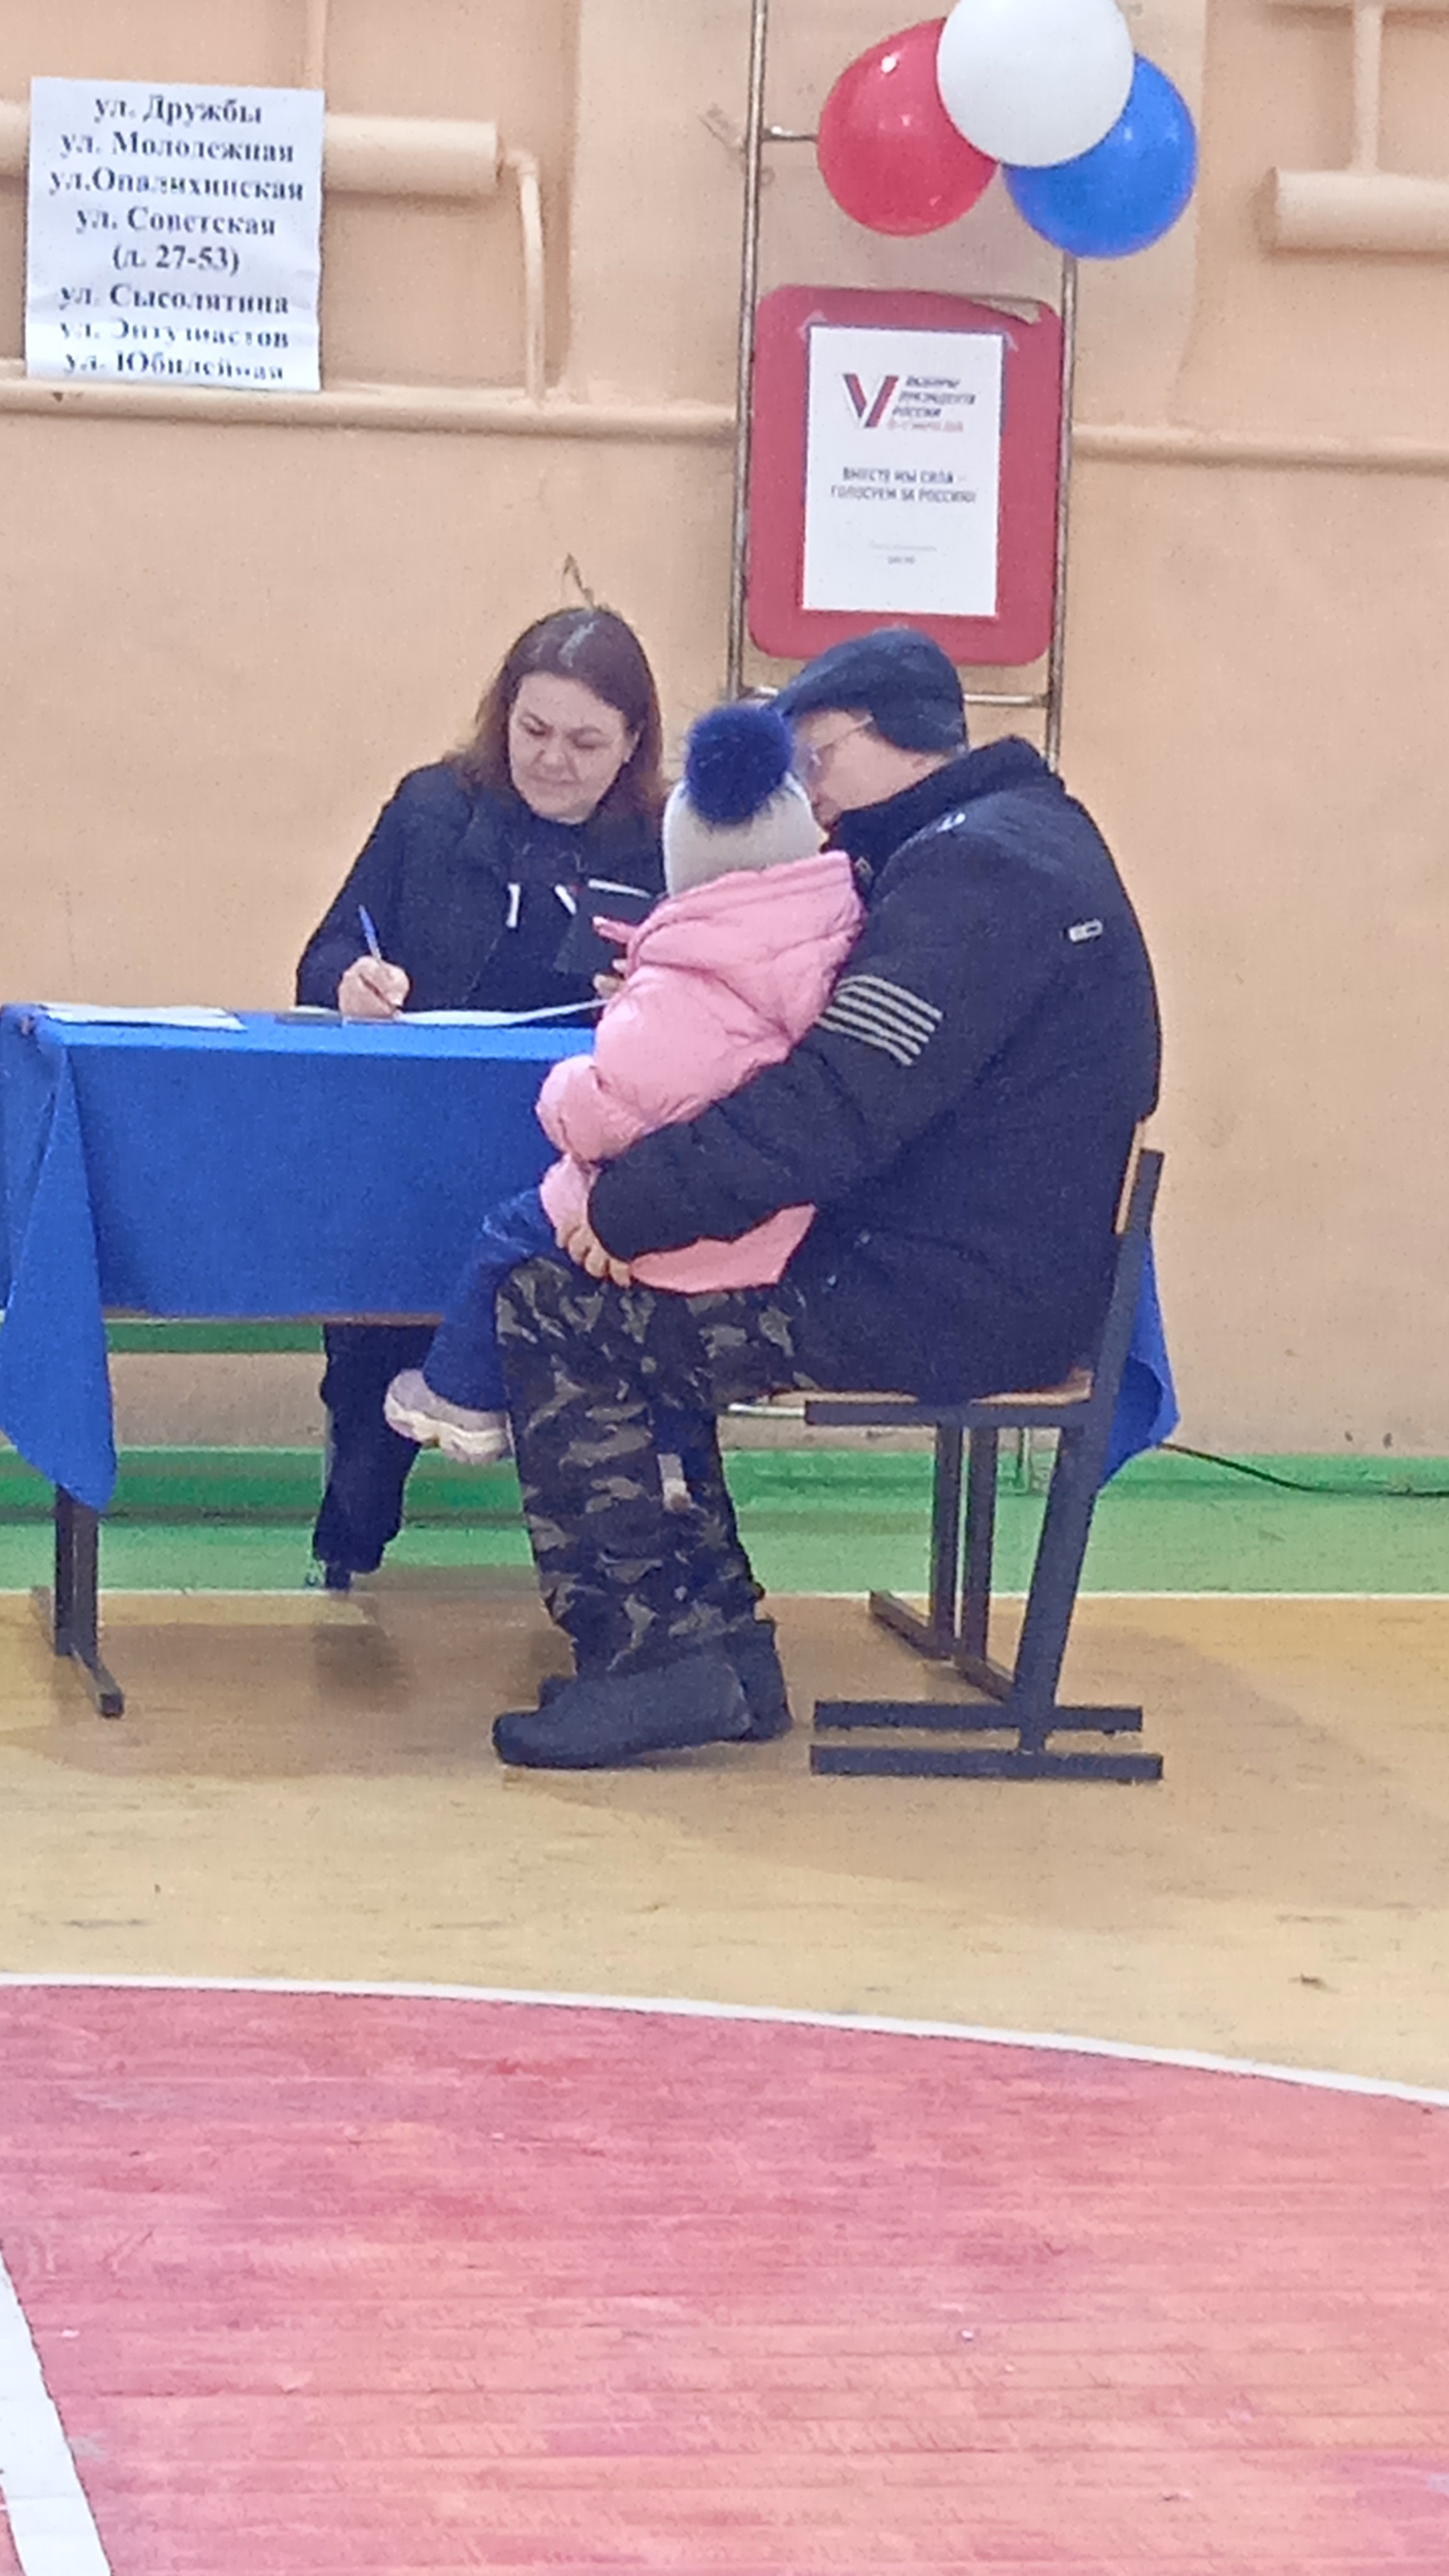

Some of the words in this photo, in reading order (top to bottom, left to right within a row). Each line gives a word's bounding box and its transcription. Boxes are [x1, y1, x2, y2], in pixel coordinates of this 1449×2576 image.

[94, 97, 136, 123] ул.
[143, 95, 262, 127] Дружбы
[60, 133, 101, 158] ул.
[75, 209, 118, 235] ул.
[128, 206, 276, 236] Советская
[155, 244, 240, 276] 27-53)
[59, 286, 99, 311] ул.
